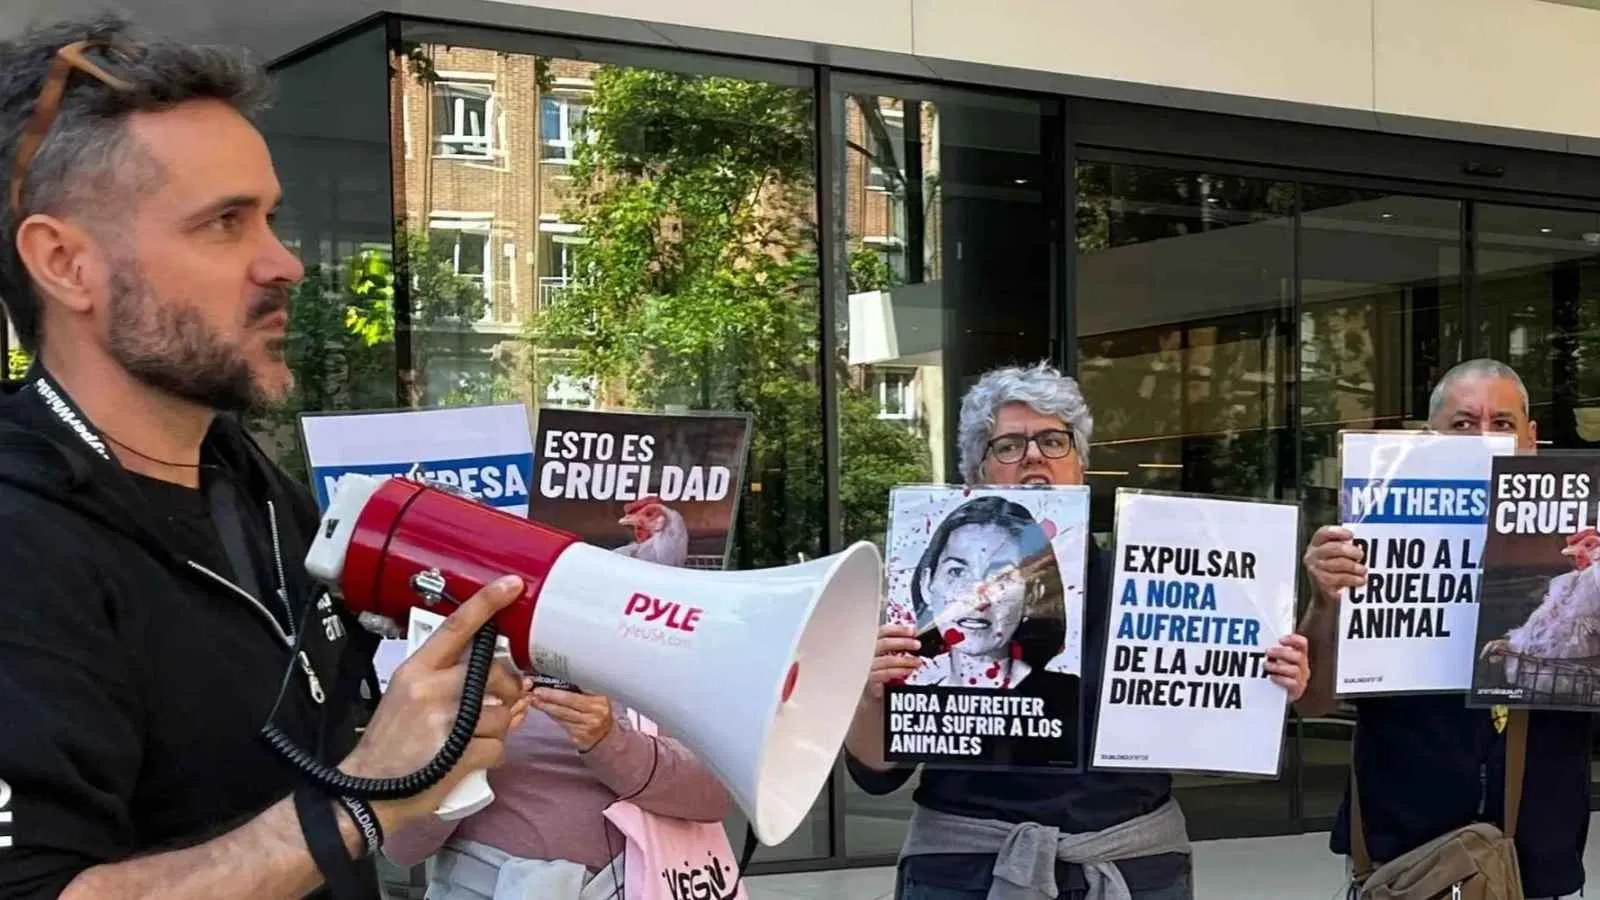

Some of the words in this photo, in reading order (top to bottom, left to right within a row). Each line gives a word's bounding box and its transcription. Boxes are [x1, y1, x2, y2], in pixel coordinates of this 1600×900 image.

[544, 430, 615, 461] ESTO
[621, 434, 656, 462] ES
[540, 460, 731, 502] CRUELDAD
[1498, 473, 1556, 499] ESTO
[1562, 473, 1590, 499] ES
[1351, 486, 1488, 517] MYTHERES
[1124, 544, 1256, 579] EXPULSAR
[1353, 538, 1378, 569] DI
[1386, 538, 1425, 569] NO
[1432, 538, 1451, 569] A
[1461, 538, 1483, 569] L
[1120, 578, 1138, 606] A
[1146, 580, 1217, 611] NORA
[1349, 573, 1483, 604] CRUELDA
[1117, 612, 1261, 646] AUFREITER
[1347, 607, 1450, 639] ANIMAL
[1113, 645, 1148, 673] DE
[1154, 647, 1187, 674] LA
[1195, 649, 1270, 679] JUNT
[890, 692, 941, 713] NORA
[945, 694, 1044, 717] AUFREITER
[1109, 678, 1242, 709] DIRECTIVA
[890, 713, 937, 733] DEJA
[942, 715, 1006, 736] SUFRIR
[1010, 718, 1023, 737] A
[1028, 718, 1063, 739] LOS
[889, 734, 982, 756] ANIMALES
